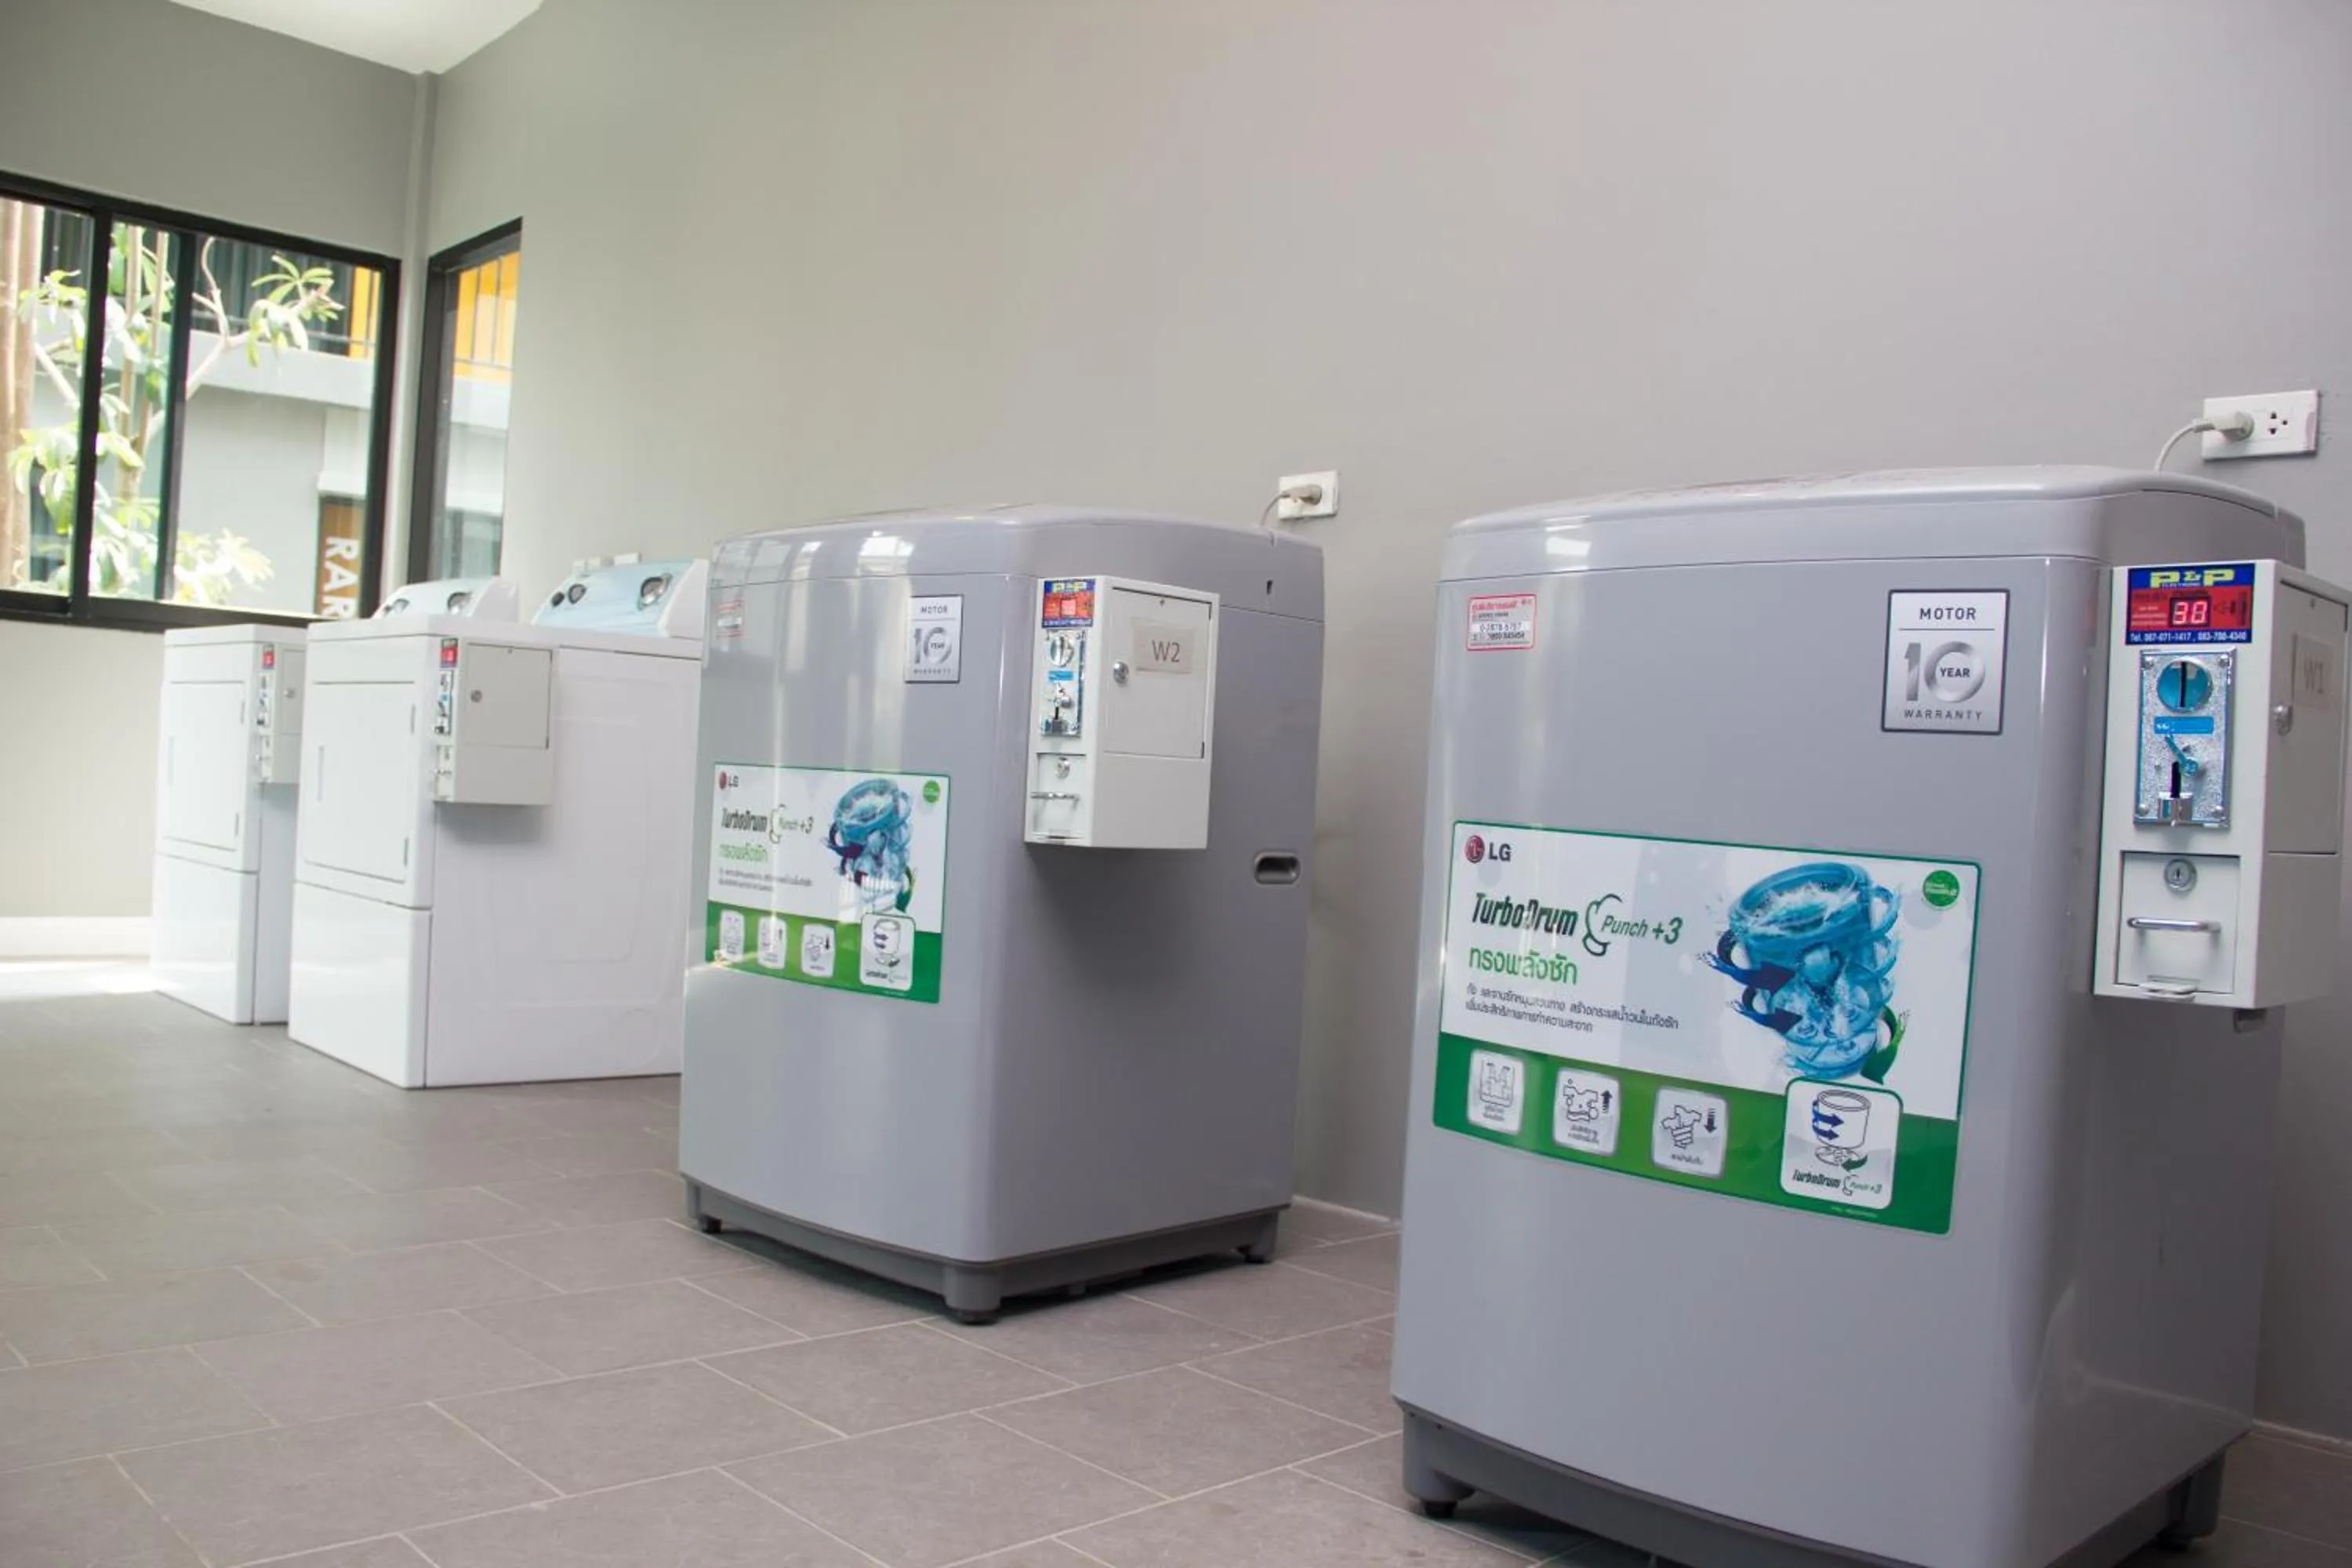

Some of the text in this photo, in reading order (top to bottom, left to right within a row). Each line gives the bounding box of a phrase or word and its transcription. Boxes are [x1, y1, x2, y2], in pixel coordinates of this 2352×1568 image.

[1919, 608, 1976, 620] MOTOR
[1152, 639, 1180, 662] W2
[1904, 641, 1986, 703] 10
[1940, 667, 1970, 678] YEAR
[1904, 709, 1983, 721] WARRANTY
[1488, 843, 1512, 862] LG
[1472, 892, 1683, 945] TurboDrum Punch +3
